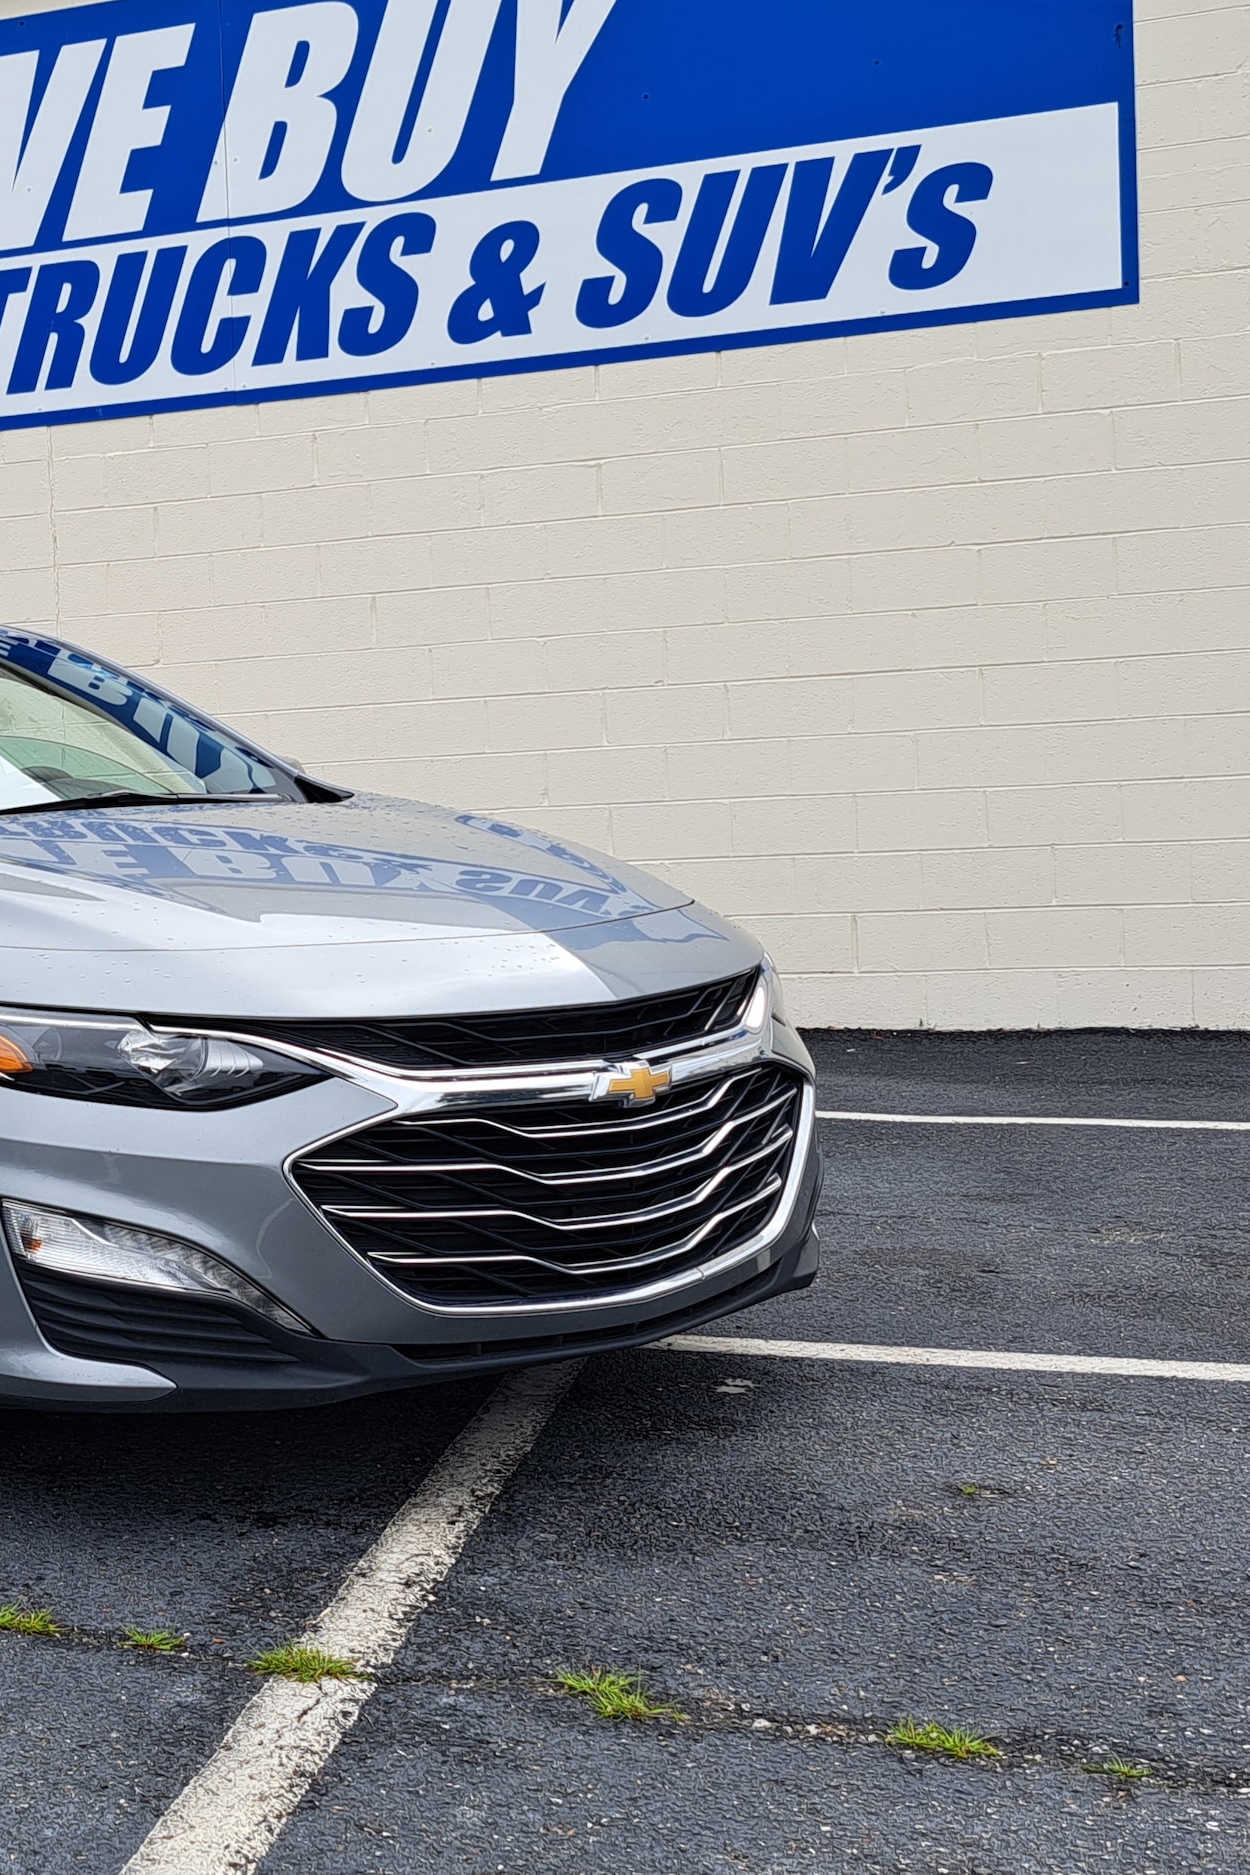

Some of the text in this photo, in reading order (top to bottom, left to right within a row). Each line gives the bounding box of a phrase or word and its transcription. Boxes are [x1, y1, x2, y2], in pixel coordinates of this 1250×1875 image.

[198, 0, 615, 221] BUY
[448, 221, 545, 344] &
[576, 145, 993, 329] SUV'S
